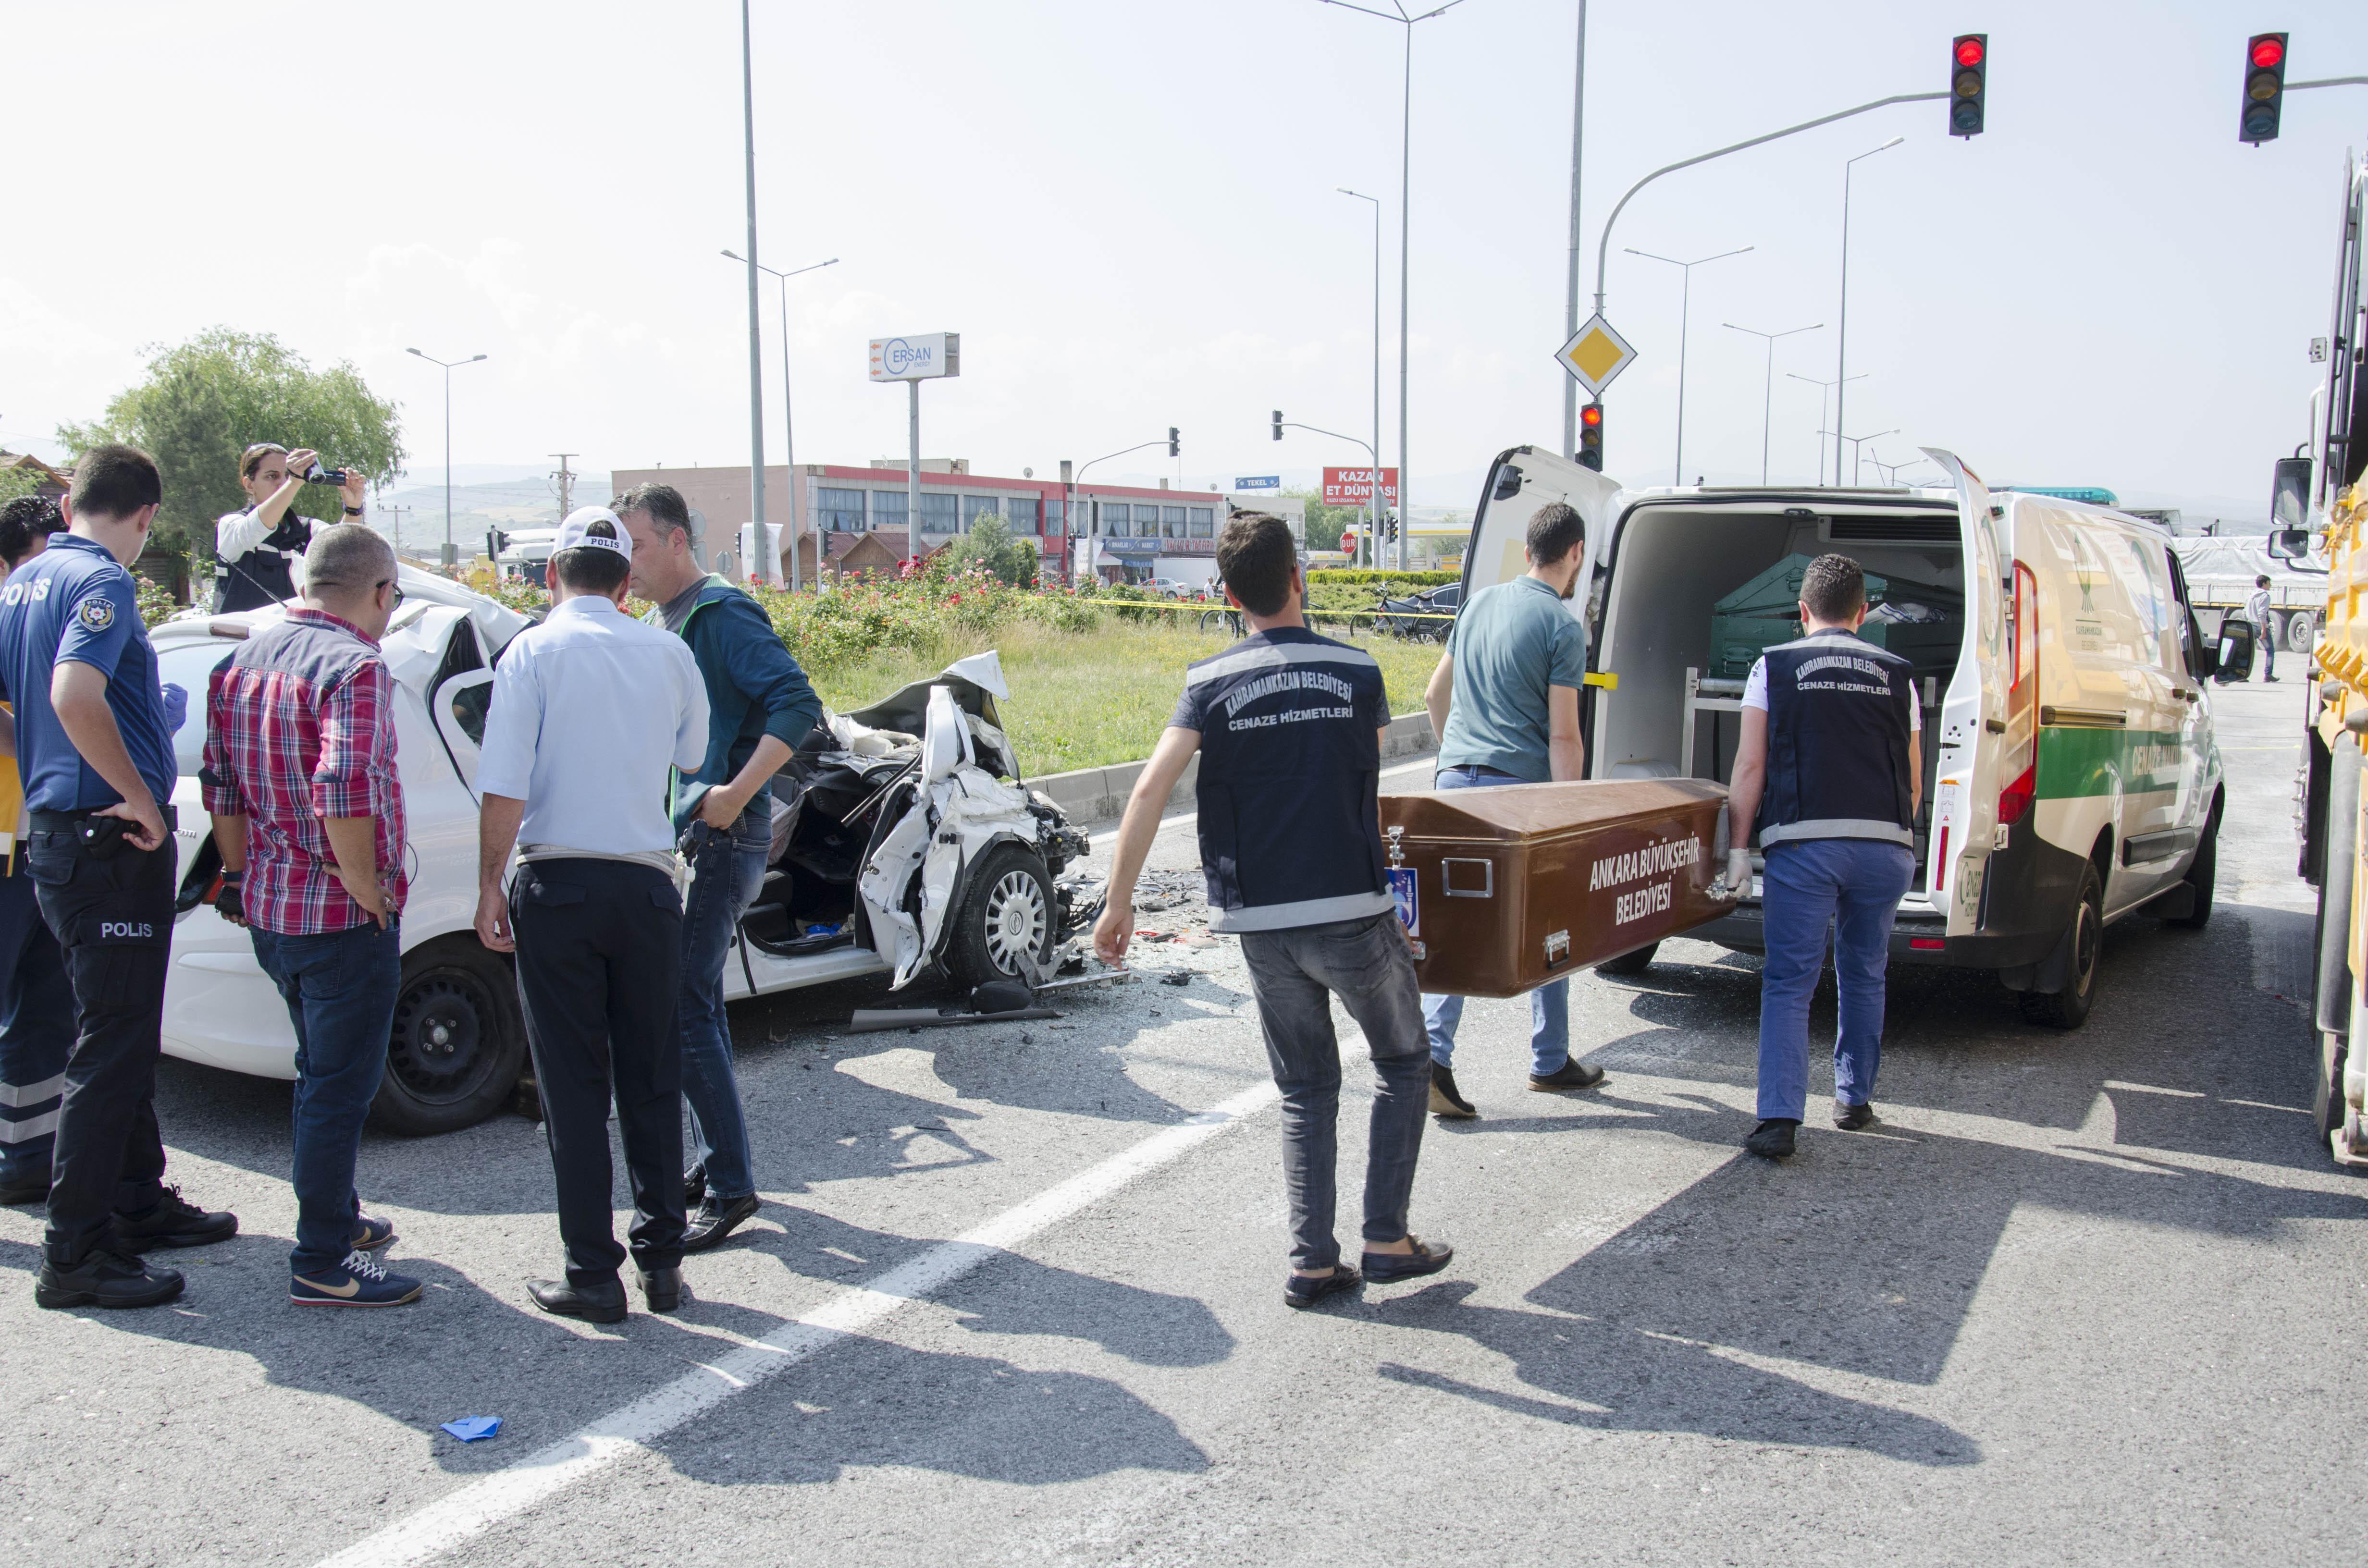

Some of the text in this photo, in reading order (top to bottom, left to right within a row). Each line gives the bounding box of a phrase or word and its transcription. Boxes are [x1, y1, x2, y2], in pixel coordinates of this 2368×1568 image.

[893, 347, 931, 363] ERSAN
[1326, 485, 1341, 496] ET
[591, 539, 620, 549] POLIS
[1341, 539, 1355, 548] DUR
[1796, 656, 1889, 686] KAHRAMANKAZAN BELEDİYESİ
[1225, 671, 1352, 718] KAHRAMANKAZAN BELEDİYESİ
[1797, 681, 1891, 696] CENAZE HİZMETLERİ
[1228, 705, 1353, 732] CENAZE HİZMETLERİ
[2133, 745, 2162, 776] CENAZE
[1589, 831, 1700, 892] ANKARA BÜYÜKŞEHİR
[1616, 875, 1671, 926] BELEDİYESİ
